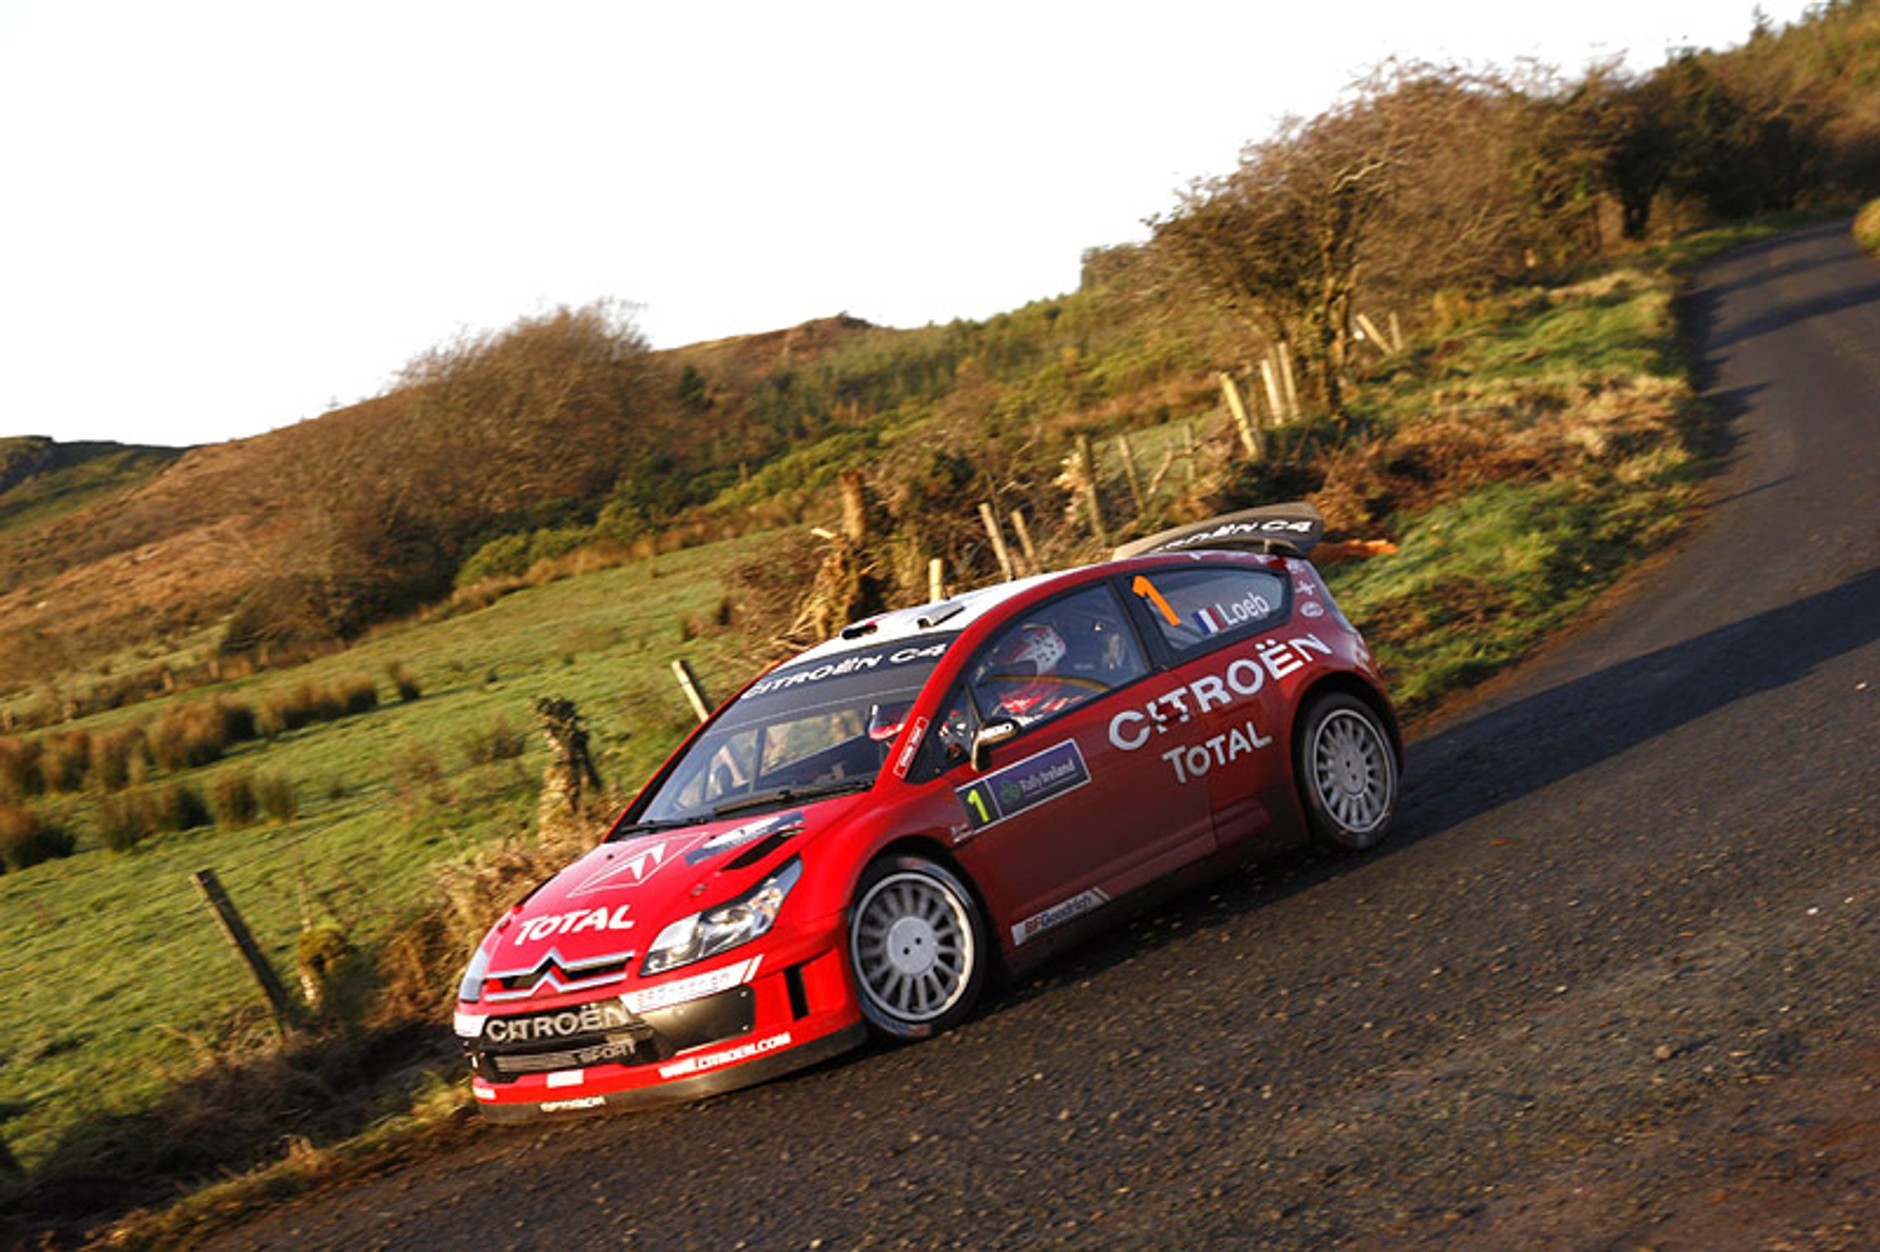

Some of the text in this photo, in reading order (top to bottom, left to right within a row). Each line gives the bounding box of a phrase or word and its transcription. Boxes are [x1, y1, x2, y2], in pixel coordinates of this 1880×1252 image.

[1132, 575, 1182, 626] 1
[1216, 592, 1270, 626] Loeb
[889, 643, 949, 664] C4
[1109, 633, 1333, 750] CITROËN
[967, 789, 991, 823] 1
